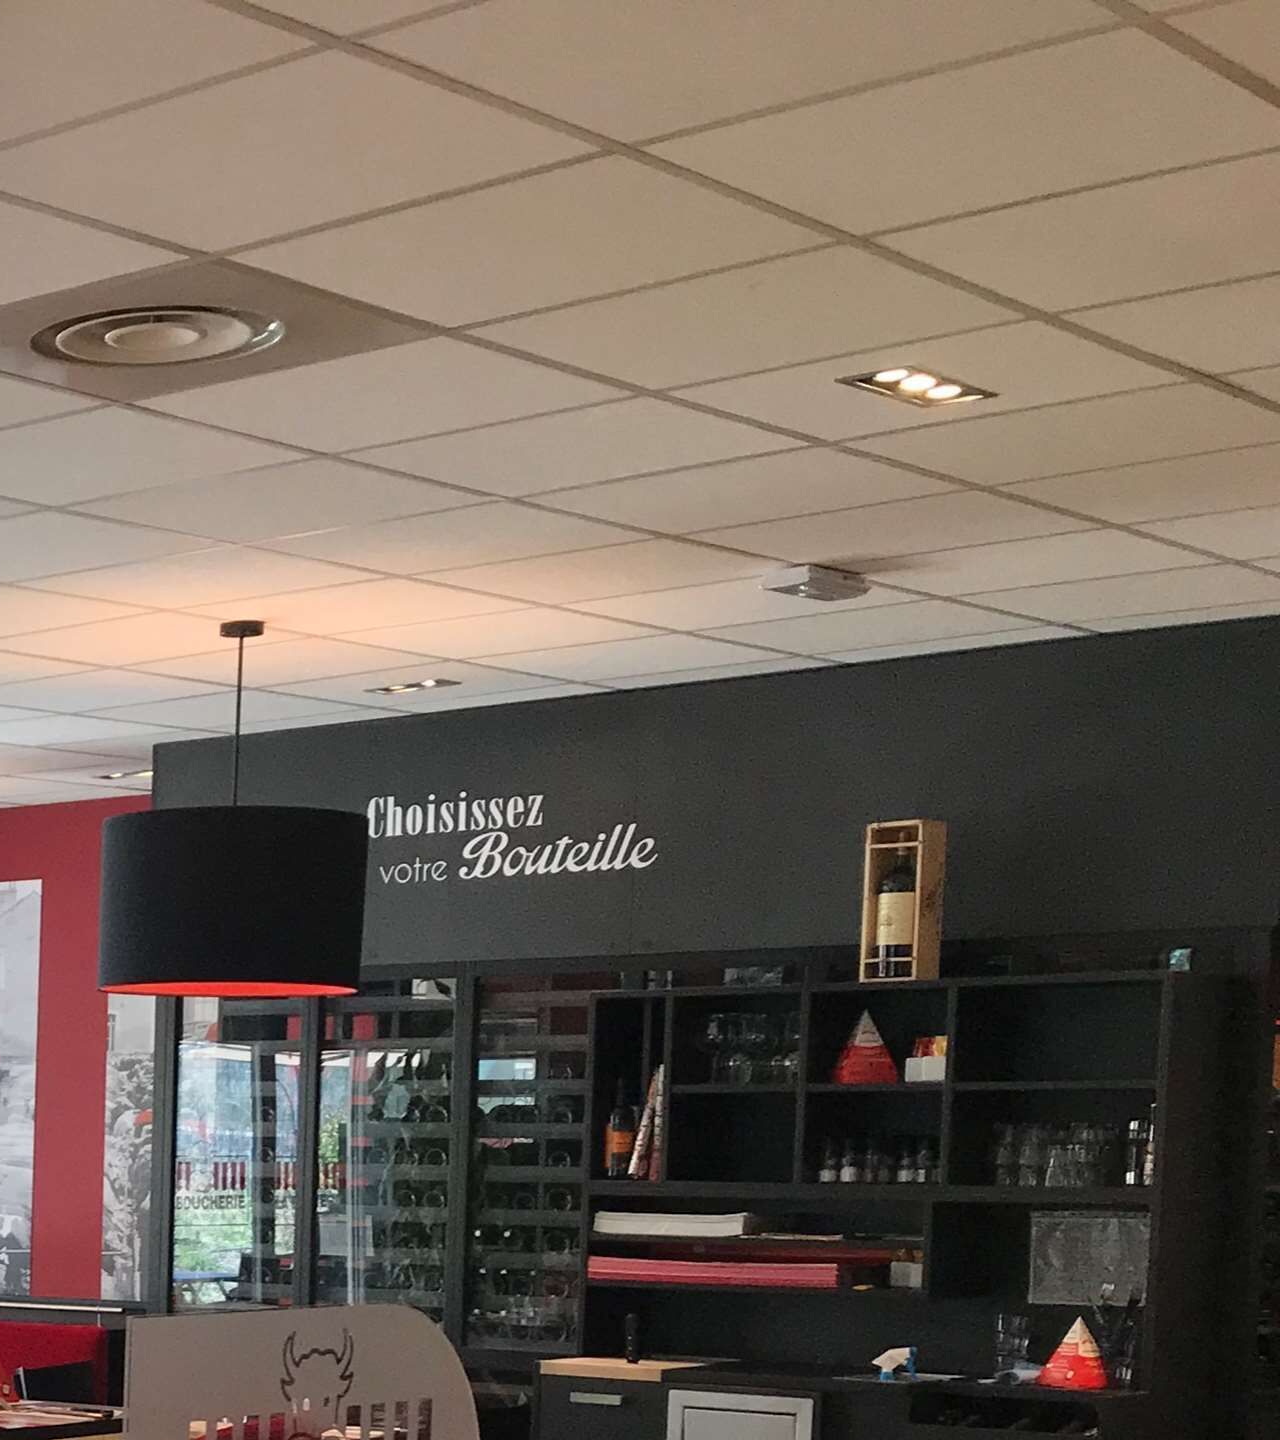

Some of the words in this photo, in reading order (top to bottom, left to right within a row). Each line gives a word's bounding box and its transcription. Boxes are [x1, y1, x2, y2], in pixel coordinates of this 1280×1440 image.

[367, 790, 545, 839] Choisissez
[379, 856, 448, 884] votre
[458, 822, 659, 880] Bouteille
